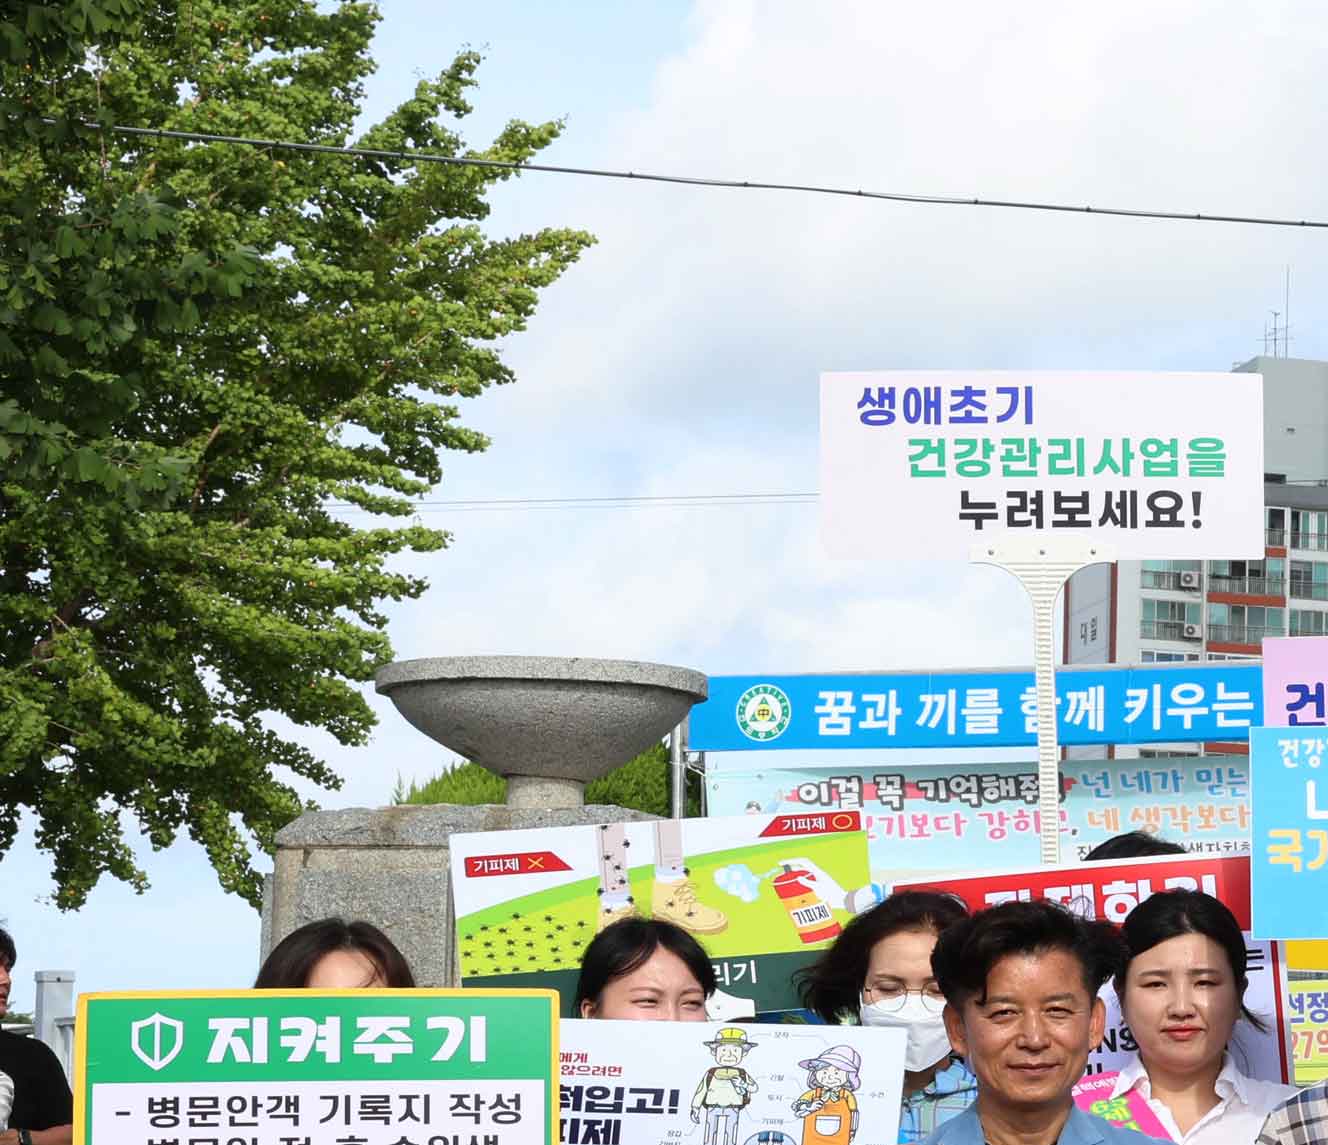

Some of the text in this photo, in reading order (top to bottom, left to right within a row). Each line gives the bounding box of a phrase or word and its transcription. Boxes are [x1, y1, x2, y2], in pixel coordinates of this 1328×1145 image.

[857, 385, 1035, 427] 생애초기
[907, 437, 1228, 479] 건강관리사업을
[958, 490, 1203, 530] 누려보세요!
[815, 690, 901, 735] 꿈과
[916, 689, 1003, 734] 끼를
[1123, 682, 1254, 730] 키우는
[799, 776, 862, 808] 이걸
[874, 776, 904, 809] 꼭
[1082, 769, 1112, 799] 넌
[1121, 769, 1184, 795] 네가
[782, 817, 826, 832] 기피제
[1087, 808, 1120, 834] 네
[473, 857, 519, 873] 기피제
[794, 906, 830, 926] 기피제
[713, 960, 757, 985] 리기
[206, 1015, 487, 1065] 지켜주기
[147, 1092, 522, 1128] 병문안객 기록지 작성
